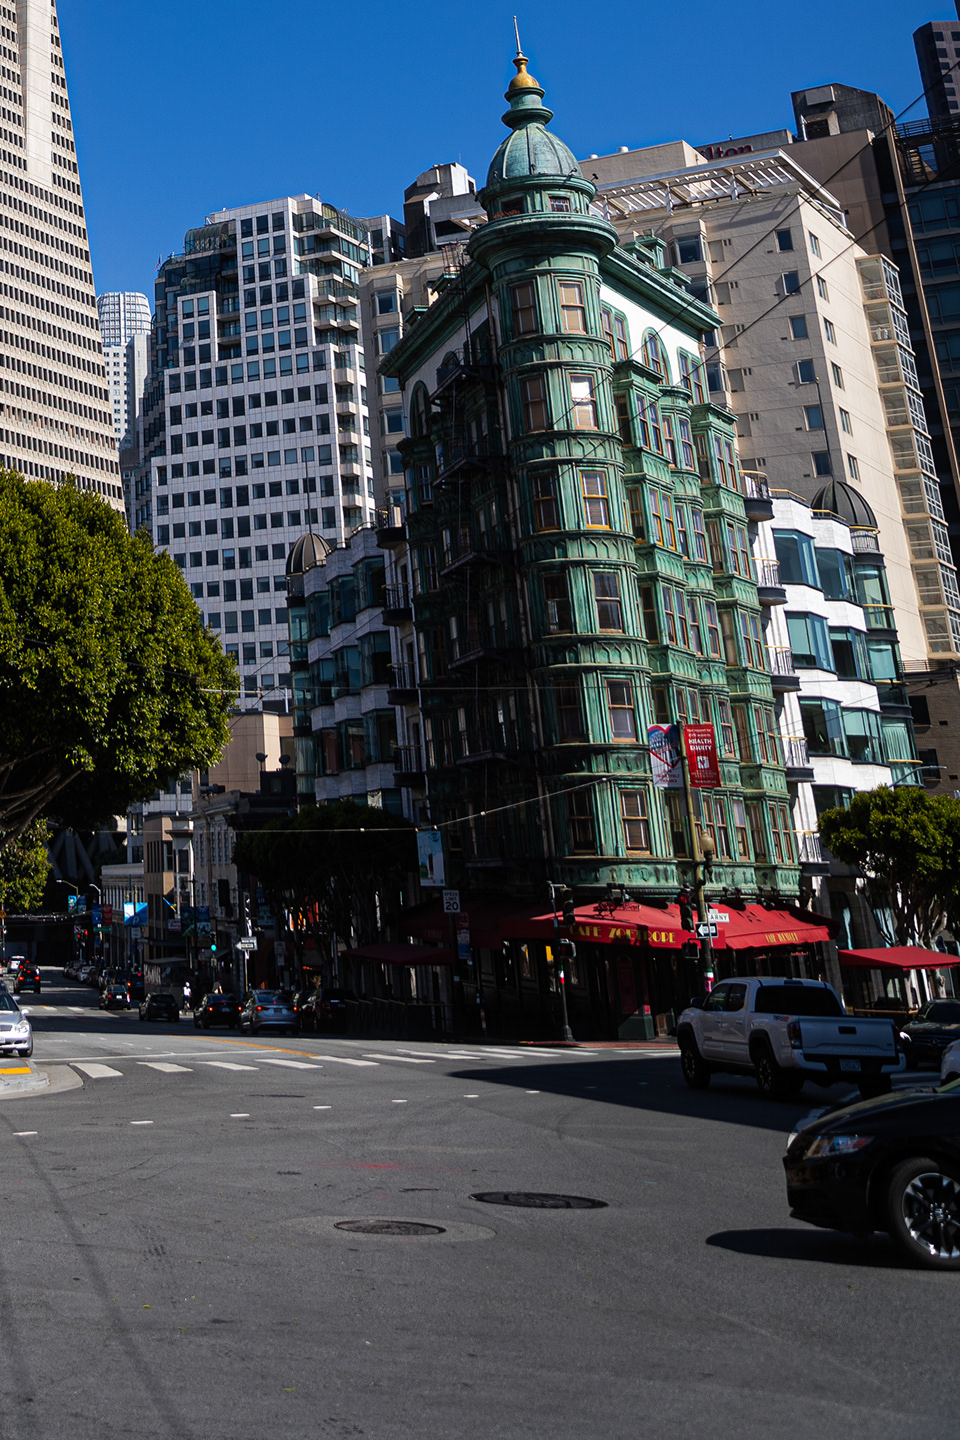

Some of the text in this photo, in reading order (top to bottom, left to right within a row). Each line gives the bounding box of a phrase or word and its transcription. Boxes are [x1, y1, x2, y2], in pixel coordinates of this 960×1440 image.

[445, 901, 459, 911] 20
[569, 924, 676, 944] CAFE ZOETROPE
